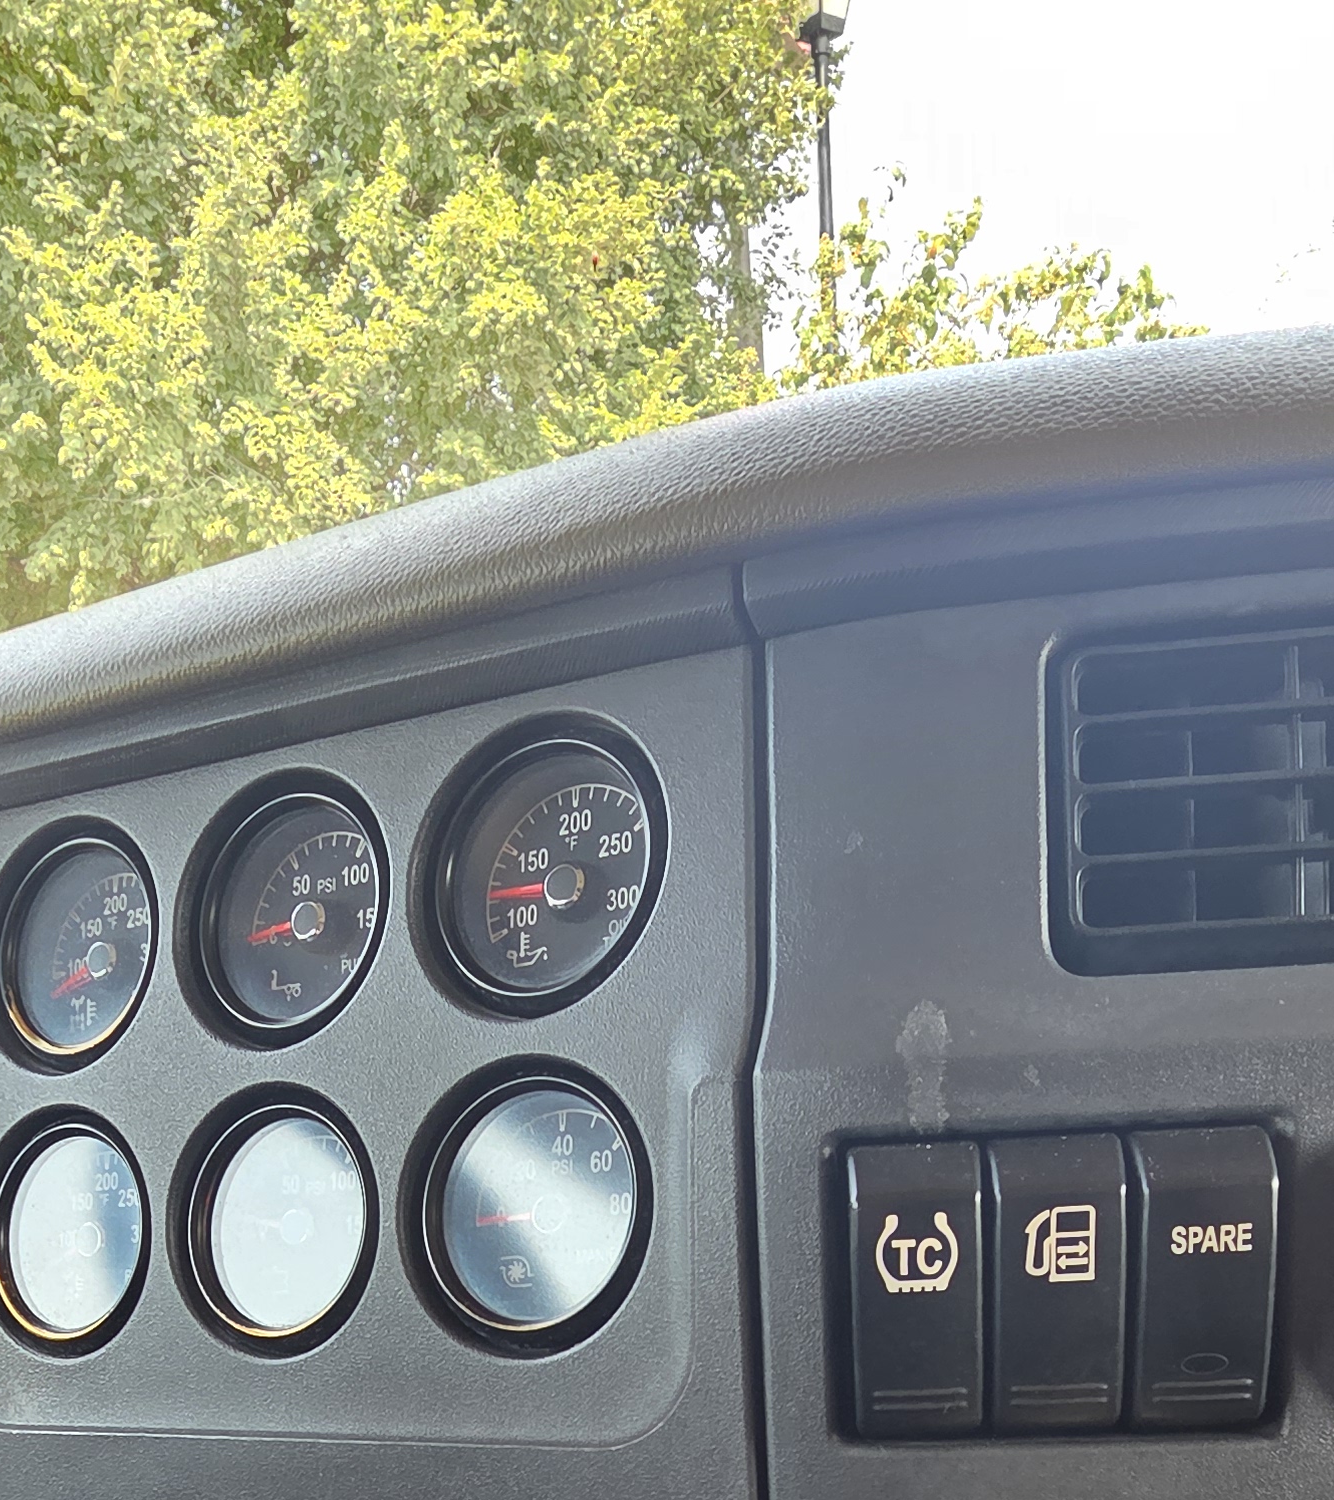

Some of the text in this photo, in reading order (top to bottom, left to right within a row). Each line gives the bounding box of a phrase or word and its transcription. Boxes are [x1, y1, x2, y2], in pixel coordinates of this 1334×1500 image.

[558, 808, 592, 836] 200
[598, 831, 632, 858] 250
[517, 848, 549, 873] 150
[292, 874, 310, 895] 50
[341, 862, 369, 887] 100
[317, 878, 337, 895] PSI
[606, 884, 639, 911] 300
[103, 894, 127, 915] 200
[356, 907, 375, 929] 15
[507, 904, 538, 929] 100
[79, 918, 102, 940] 150
[552, 1134, 574, 1156] 40
[552, 1160, 574, 1175] PSI
[590, 1150, 612, 1173] 60
[95, 1172, 119, 1191] 200
[330, 1170, 356, 1191] 100
[610, 1193, 632, 1215] 80
[346, 1215, 361, 1235] 15
[1170, 1222, 1253, 1255] SPARE
[891, 1236, 944, 1276] TC
